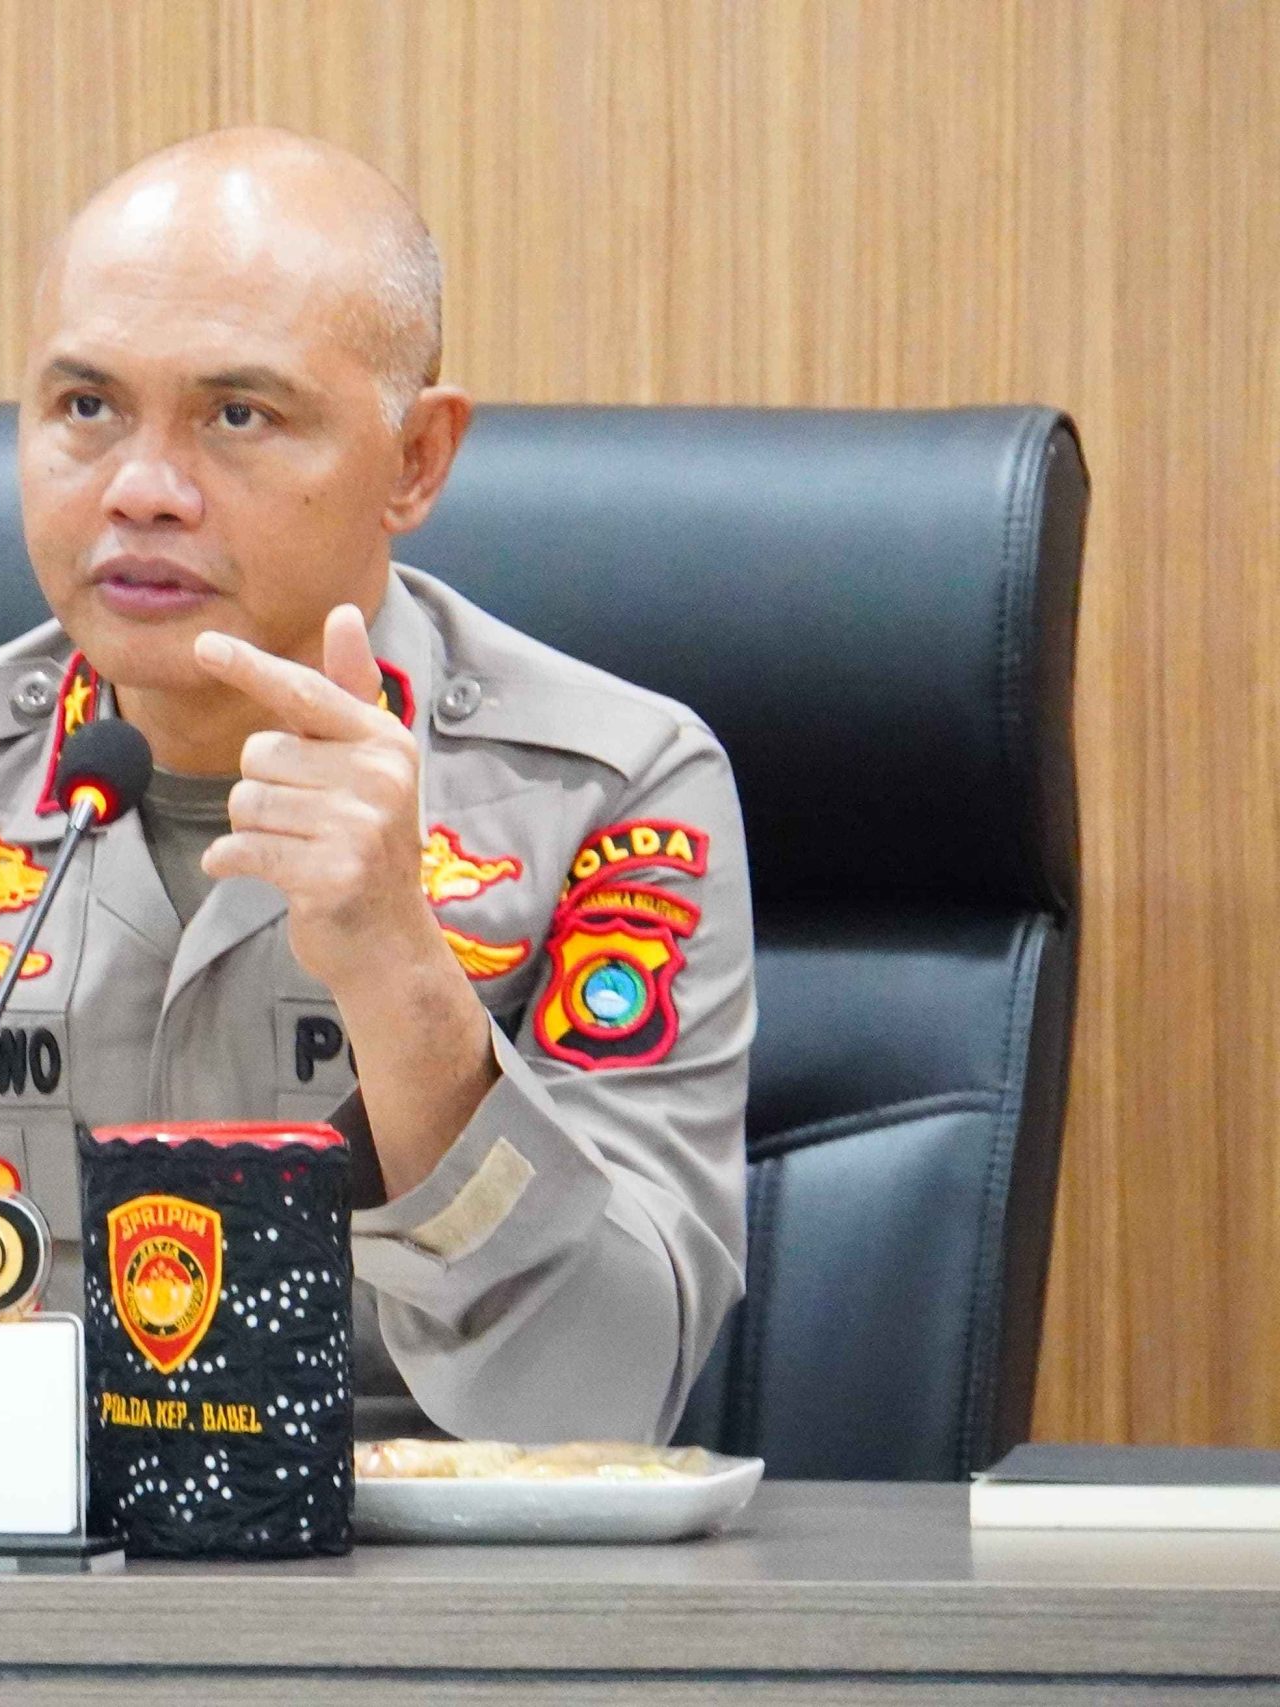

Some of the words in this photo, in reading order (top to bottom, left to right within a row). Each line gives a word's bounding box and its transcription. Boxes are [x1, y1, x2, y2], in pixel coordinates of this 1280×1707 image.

[561, 826, 693, 901] OLDA
[120, 1206, 207, 1241] SPRIPIM
[102, 1392, 152, 1427] POLDA
[202, 1401, 263, 1434] BABEL
